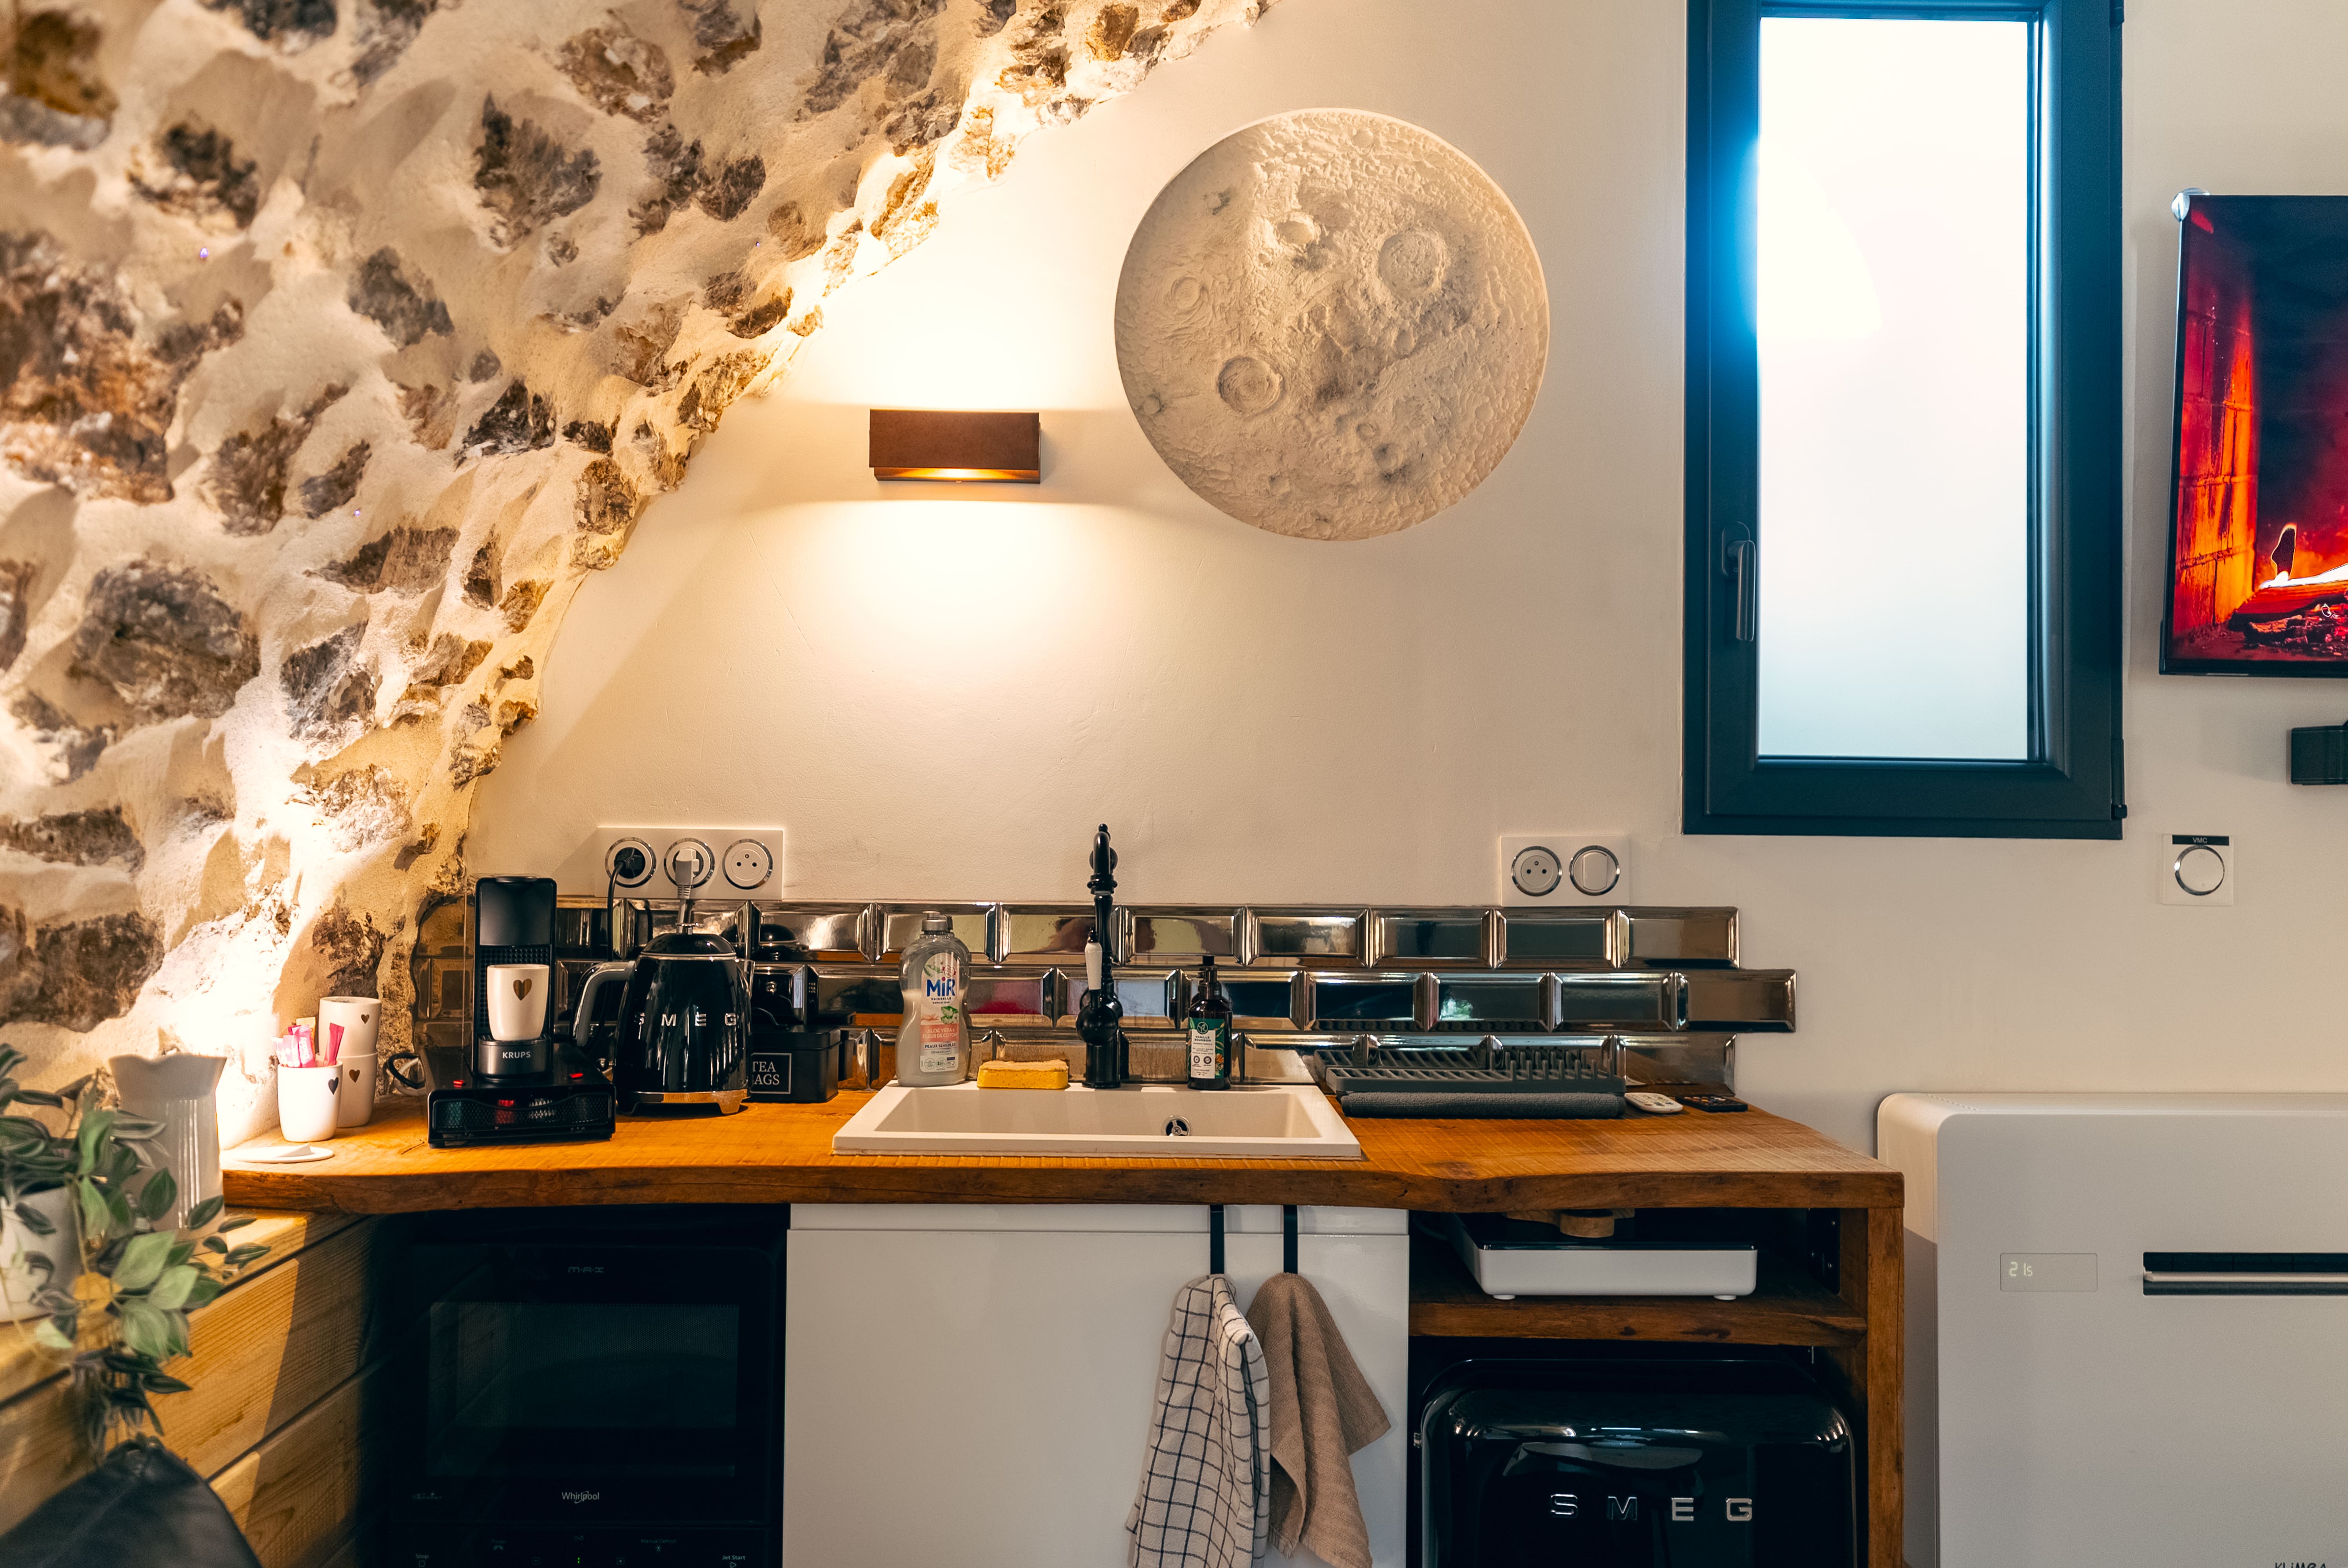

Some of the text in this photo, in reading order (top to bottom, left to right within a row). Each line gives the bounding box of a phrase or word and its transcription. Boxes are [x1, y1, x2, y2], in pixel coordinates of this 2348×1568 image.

[753, 1061, 776, 1073] TEA
[754, 1074, 780, 1085] AGS
[561, 1491, 600, 1504] Whirlpool
[1551, 1494, 1752, 1521] SMEG
